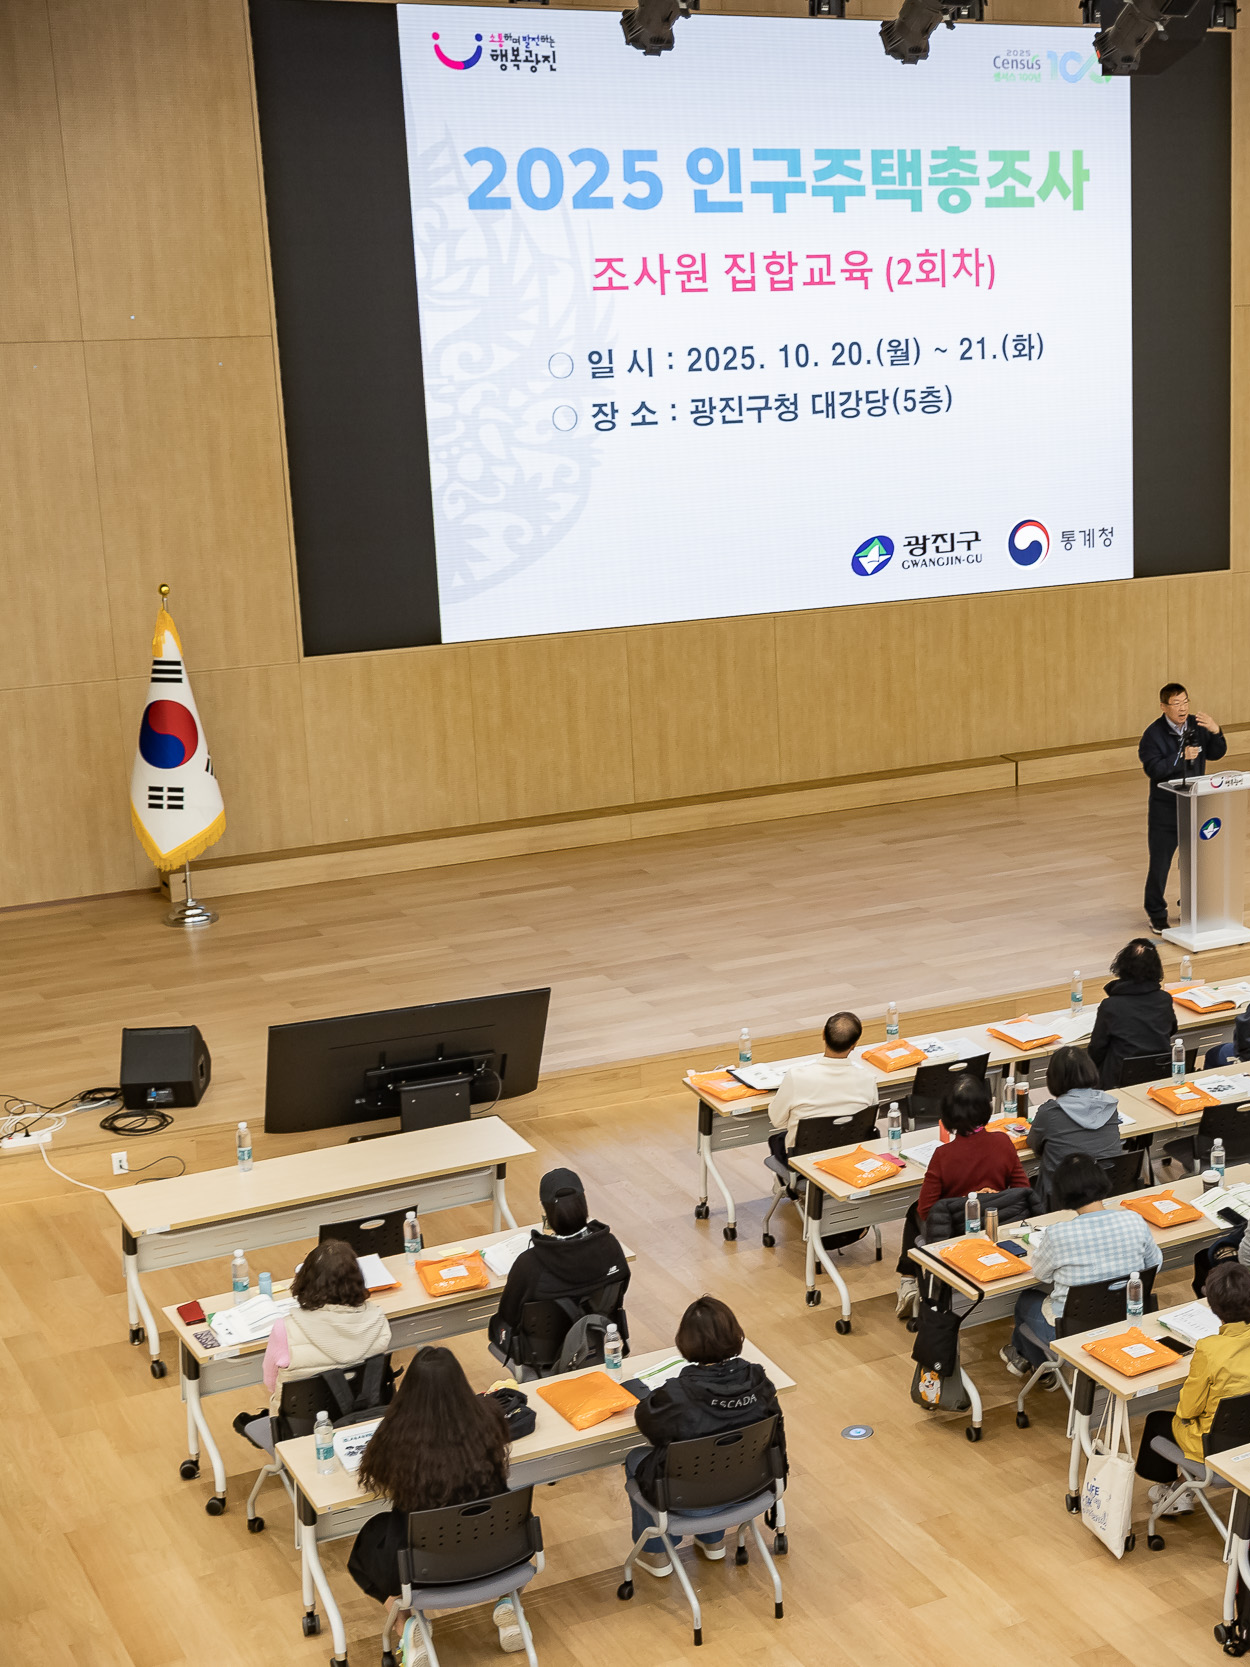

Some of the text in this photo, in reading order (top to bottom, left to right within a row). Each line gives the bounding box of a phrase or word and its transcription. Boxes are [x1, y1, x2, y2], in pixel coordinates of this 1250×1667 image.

[522, 34, 555, 49] 발전하는
[1006, 49, 1031, 57] 2025
[490, 47, 557, 73] 행복광진
[993, 55, 1041, 70] Census
[463, 145, 1091, 214] 2025 인구주택총조사
[592, 247, 996, 296] 조사원 집합교육 (2회차)
[687, 345, 766, 373] 2025.
[778, 343, 820, 369] 10.
[831, 336, 921, 367] 20.(월)
[959, 332, 1044, 362] 21.(화)
[689, 394, 799, 427] 광진구청
[811, 384, 954, 420] 대강당(5층)
[902, 531, 982, 557] 광진구
[1060, 526, 1115, 551] 통계청
[901, 554, 983, 570] GWANGJIN-GU
[711, 1393, 757, 1409] ESCADA
[1086, 1481, 1100, 1496] LIFE
